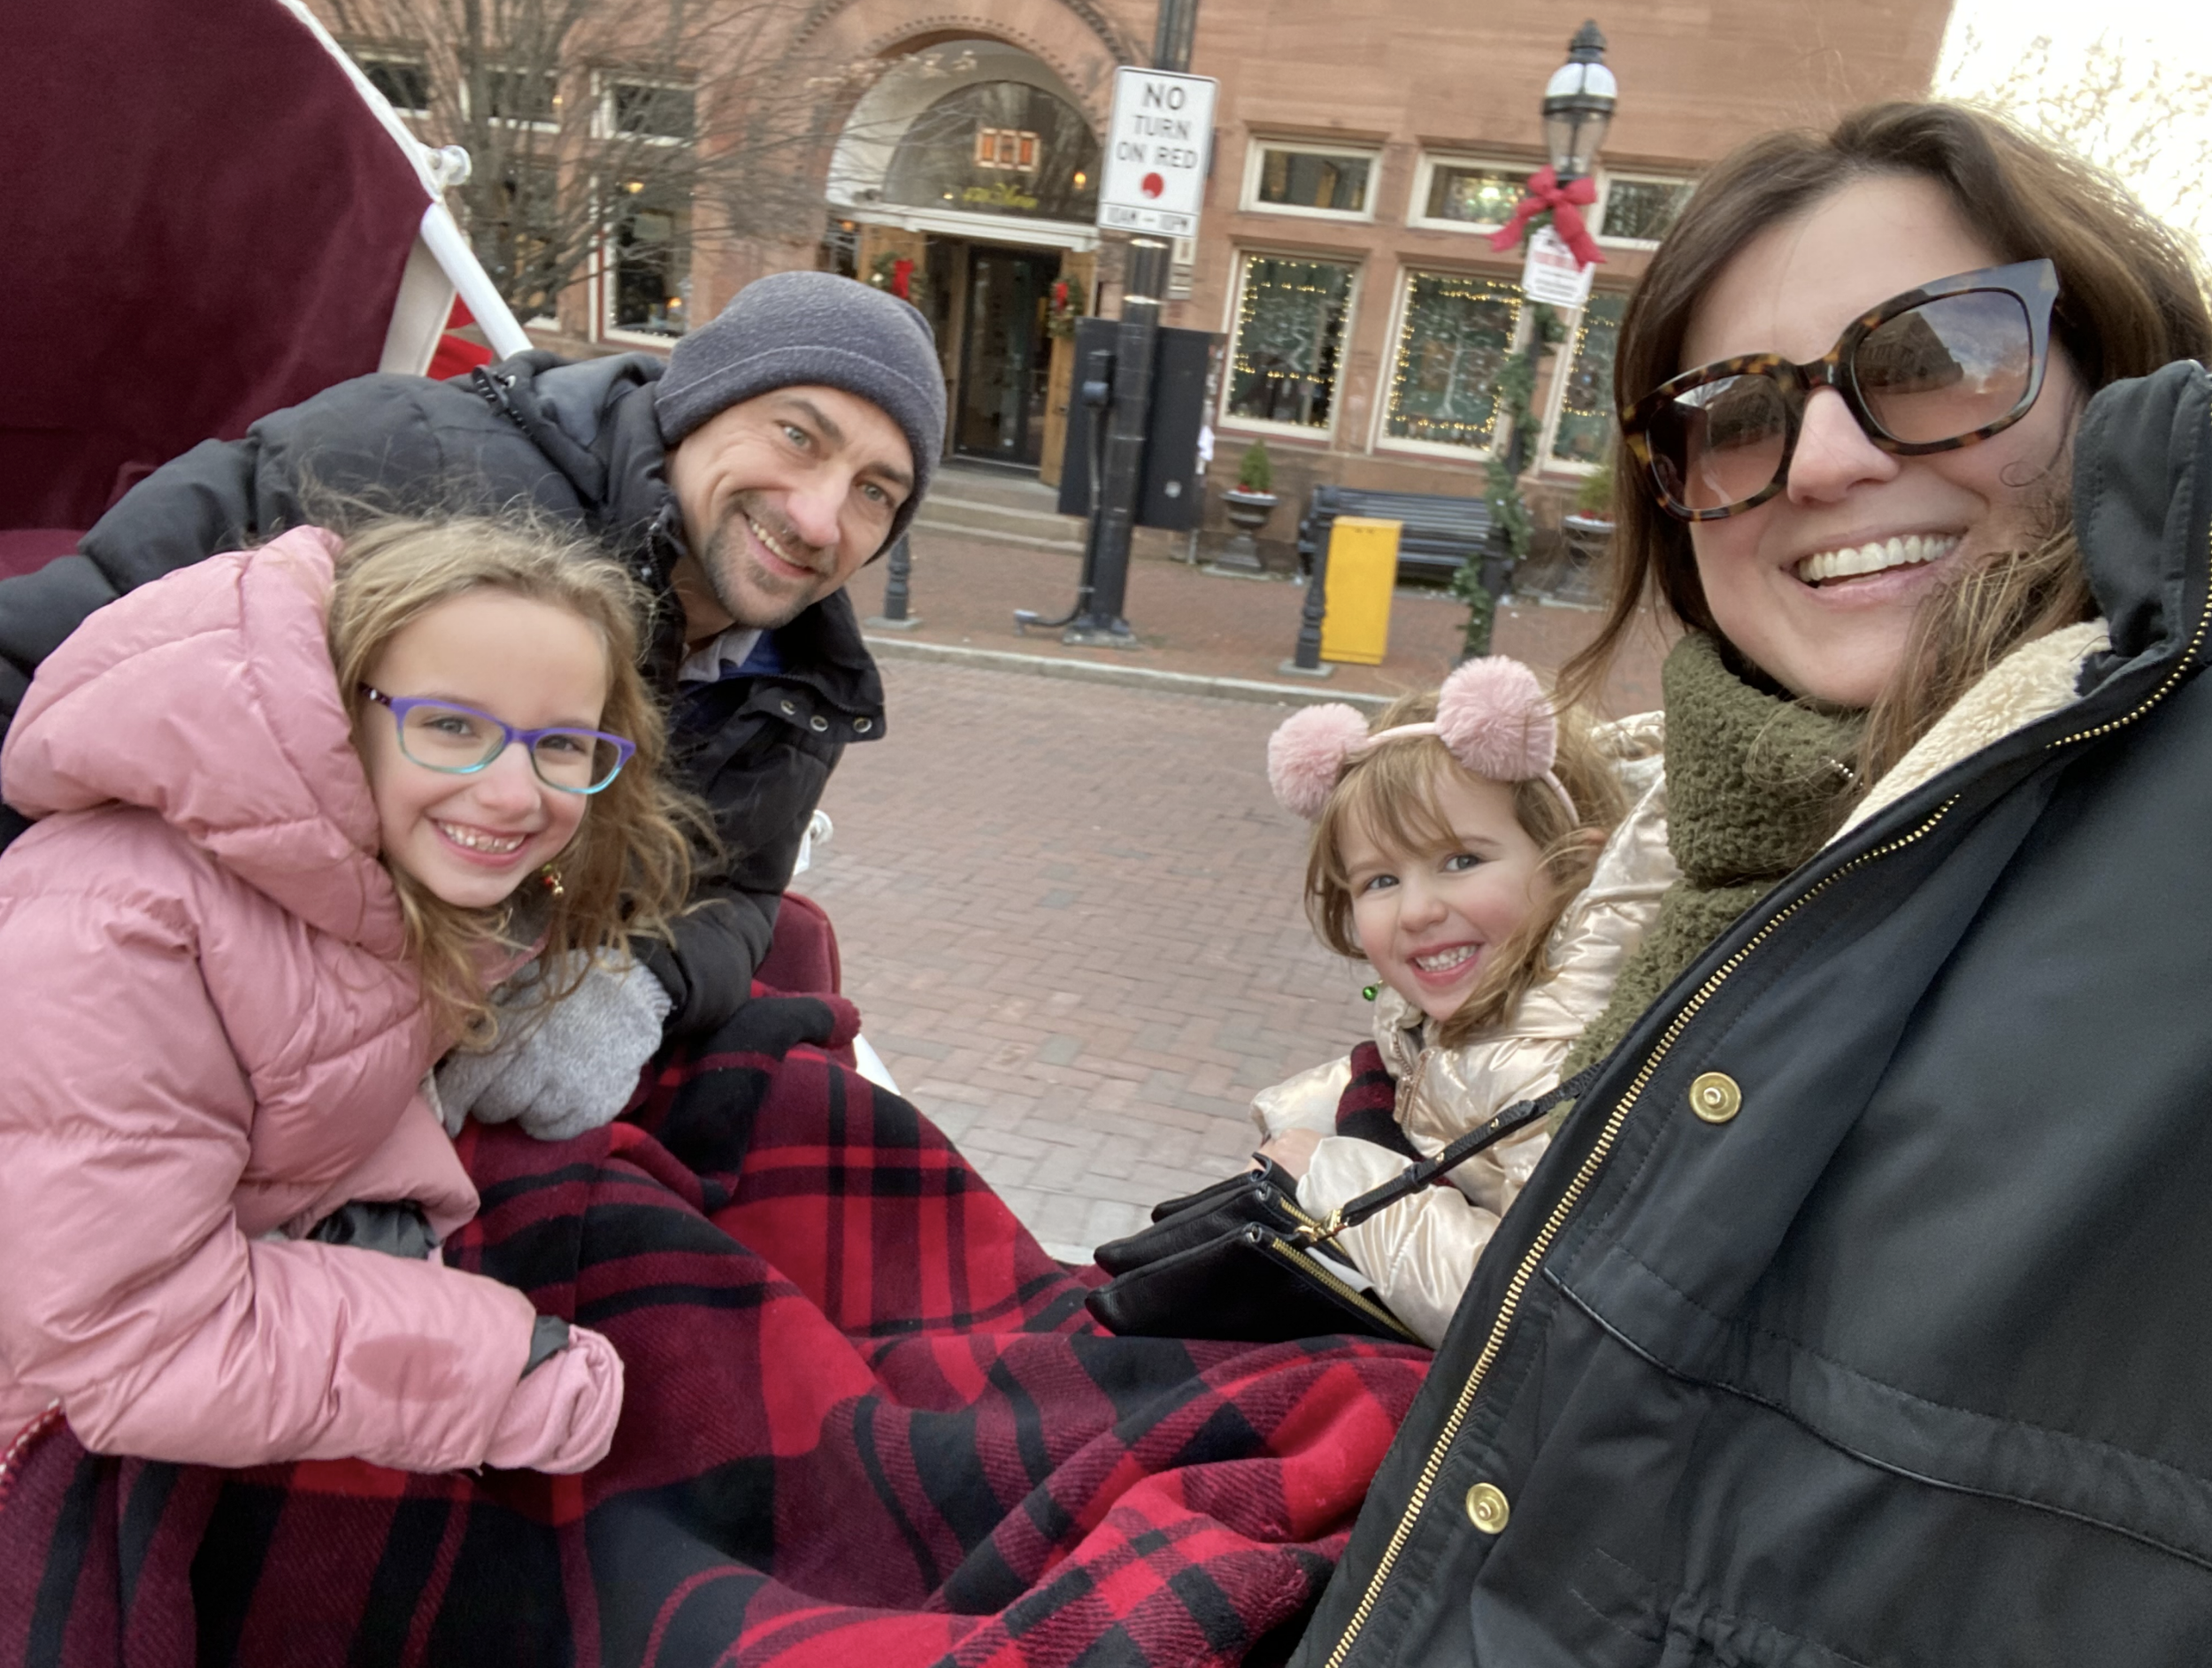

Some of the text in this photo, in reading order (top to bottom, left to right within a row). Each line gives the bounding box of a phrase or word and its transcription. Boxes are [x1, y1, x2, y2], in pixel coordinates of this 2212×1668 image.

[1142, 82, 1187, 111] NO
[1133, 114, 1192, 140] TURN
[1117, 141, 1198, 169] ON RED
